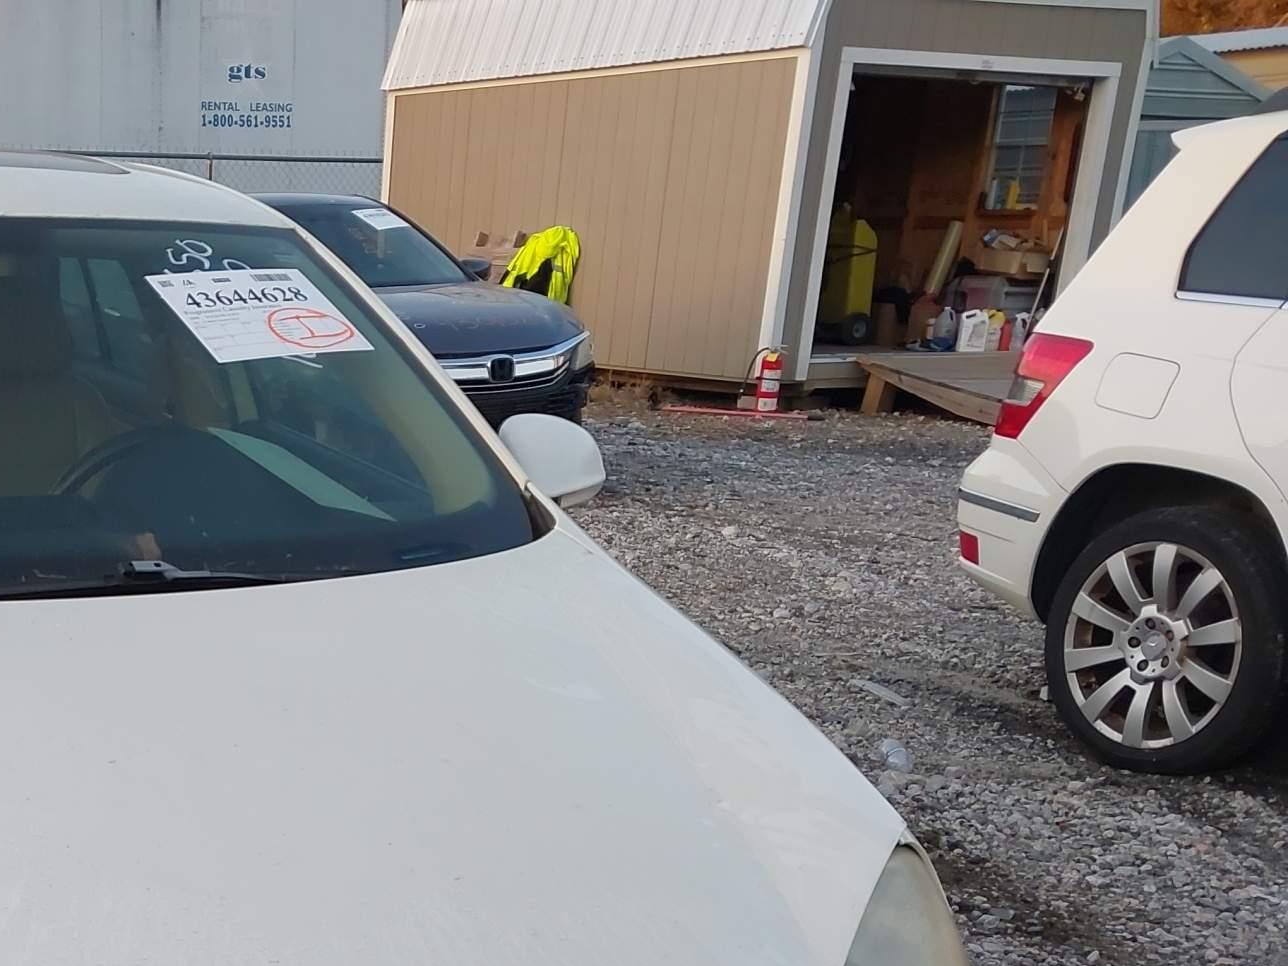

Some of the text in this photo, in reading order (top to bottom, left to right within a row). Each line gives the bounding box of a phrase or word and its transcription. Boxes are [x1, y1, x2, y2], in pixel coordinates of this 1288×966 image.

[228, 64, 266, 83] gts
[201, 101, 293, 113] RENTAL LEASING
[185, 286, 309, 309] 43644628
